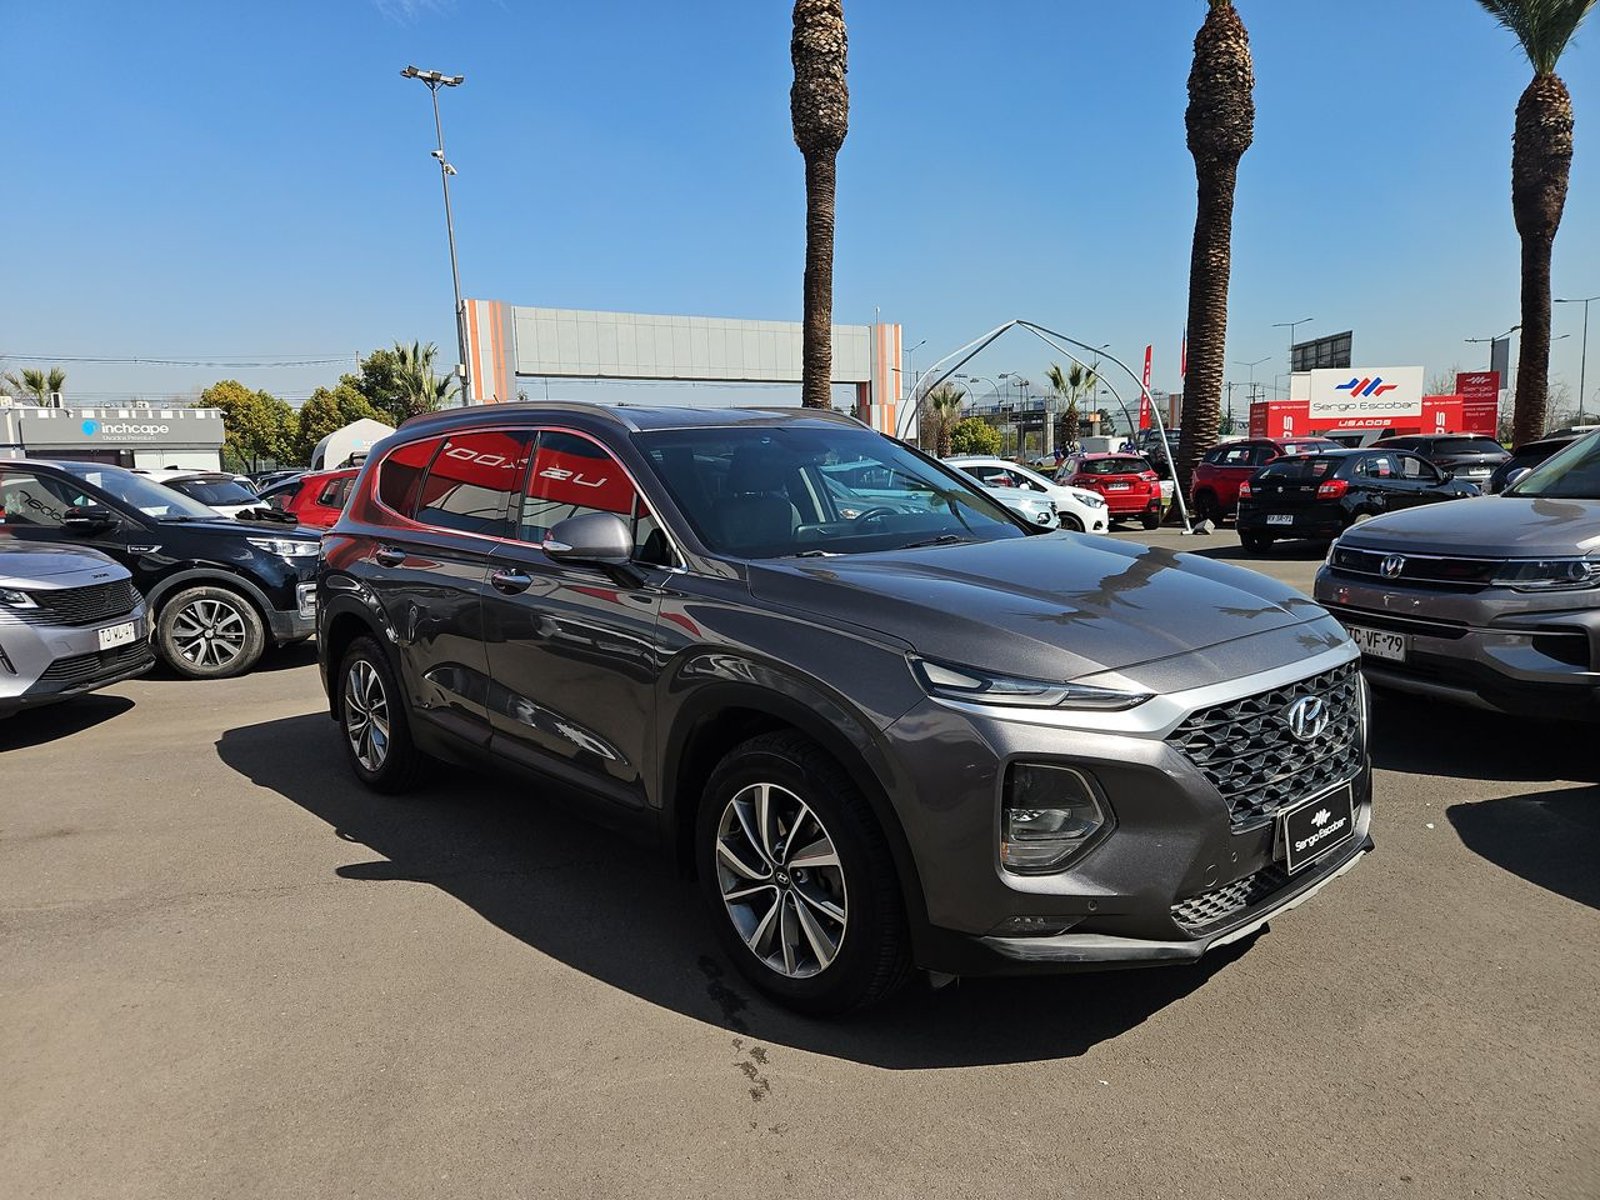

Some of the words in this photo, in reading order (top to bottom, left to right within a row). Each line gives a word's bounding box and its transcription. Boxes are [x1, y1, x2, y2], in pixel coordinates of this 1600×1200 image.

[1312, 402, 1357, 412] Sergo
[1359, 400, 1420, 411] Escobar
[101, 422, 170, 436] inchcape
[1338, 419, 1392, 427] USADOS
